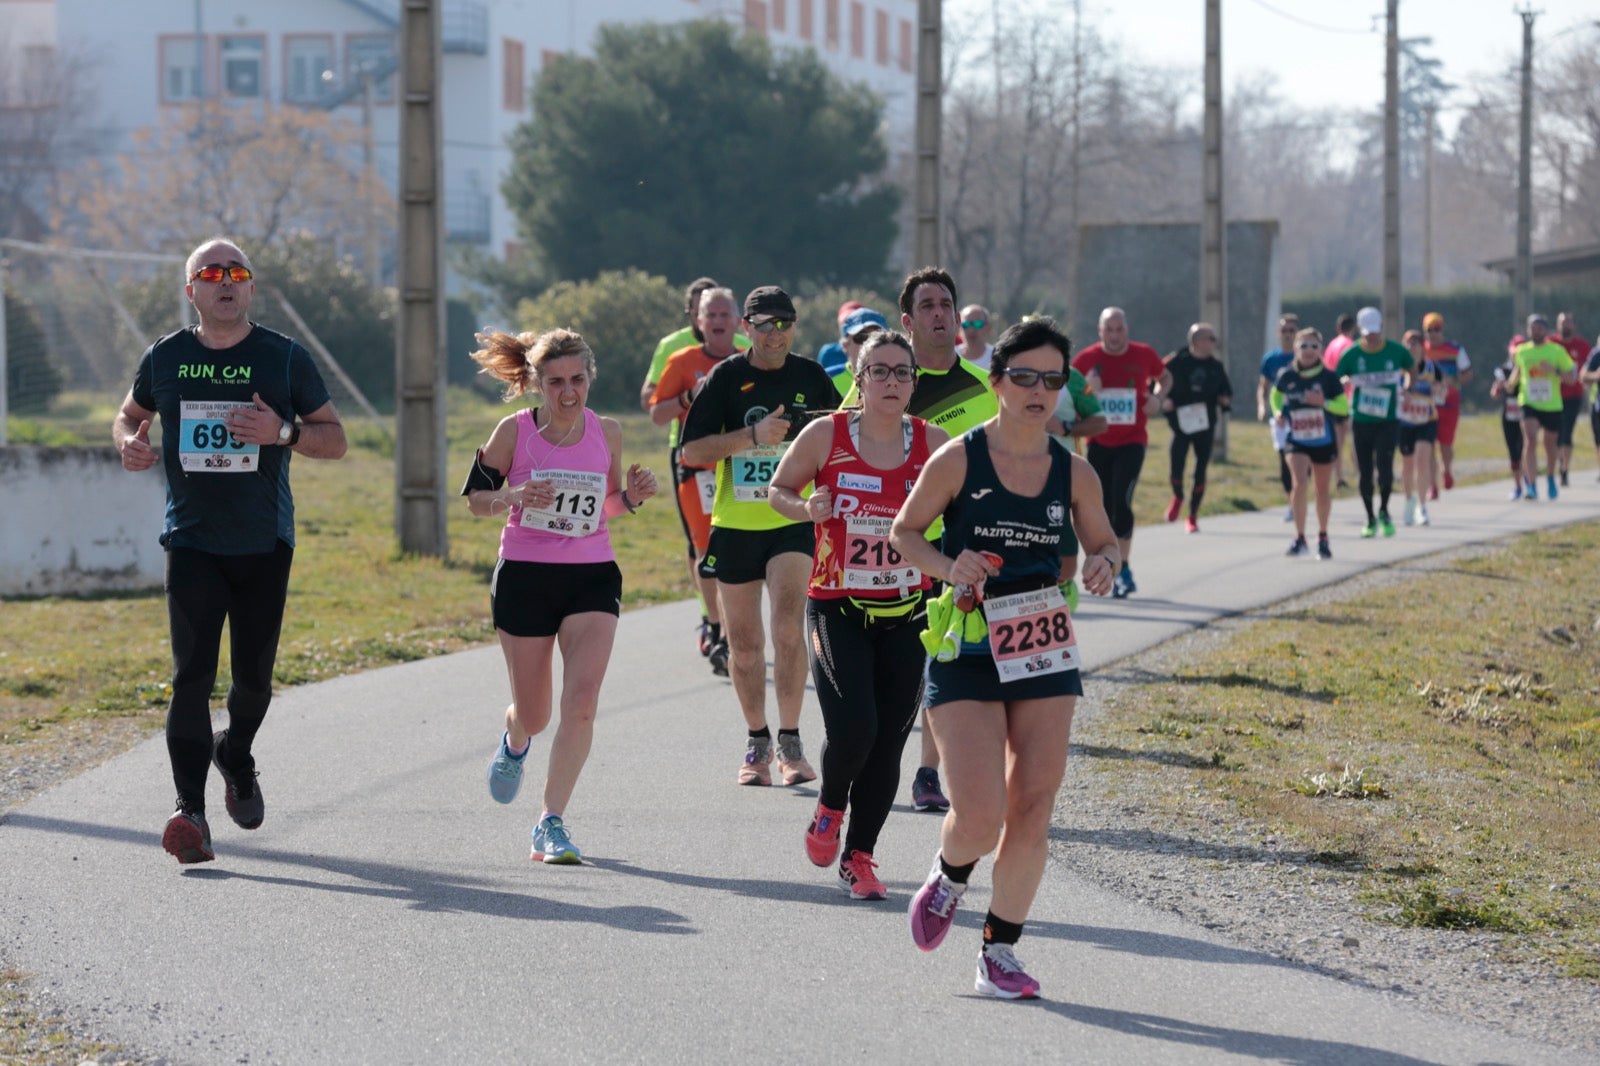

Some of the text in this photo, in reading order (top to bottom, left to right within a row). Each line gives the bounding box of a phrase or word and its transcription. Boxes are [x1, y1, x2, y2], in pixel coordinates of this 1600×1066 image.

[178, 364, 251, 379] RUN ON
[1102, 400, 1133, 411] 1001
[743, 461, 780, 482] 25
[974, 526, 1014, 537] PAZITO
[1024, 532, 1060, 545] PAZITO
[1004, 539, 1030, 548] Motril
[850, 538, 906, 567] 218
[995, 612, 1070, 655] 2238
